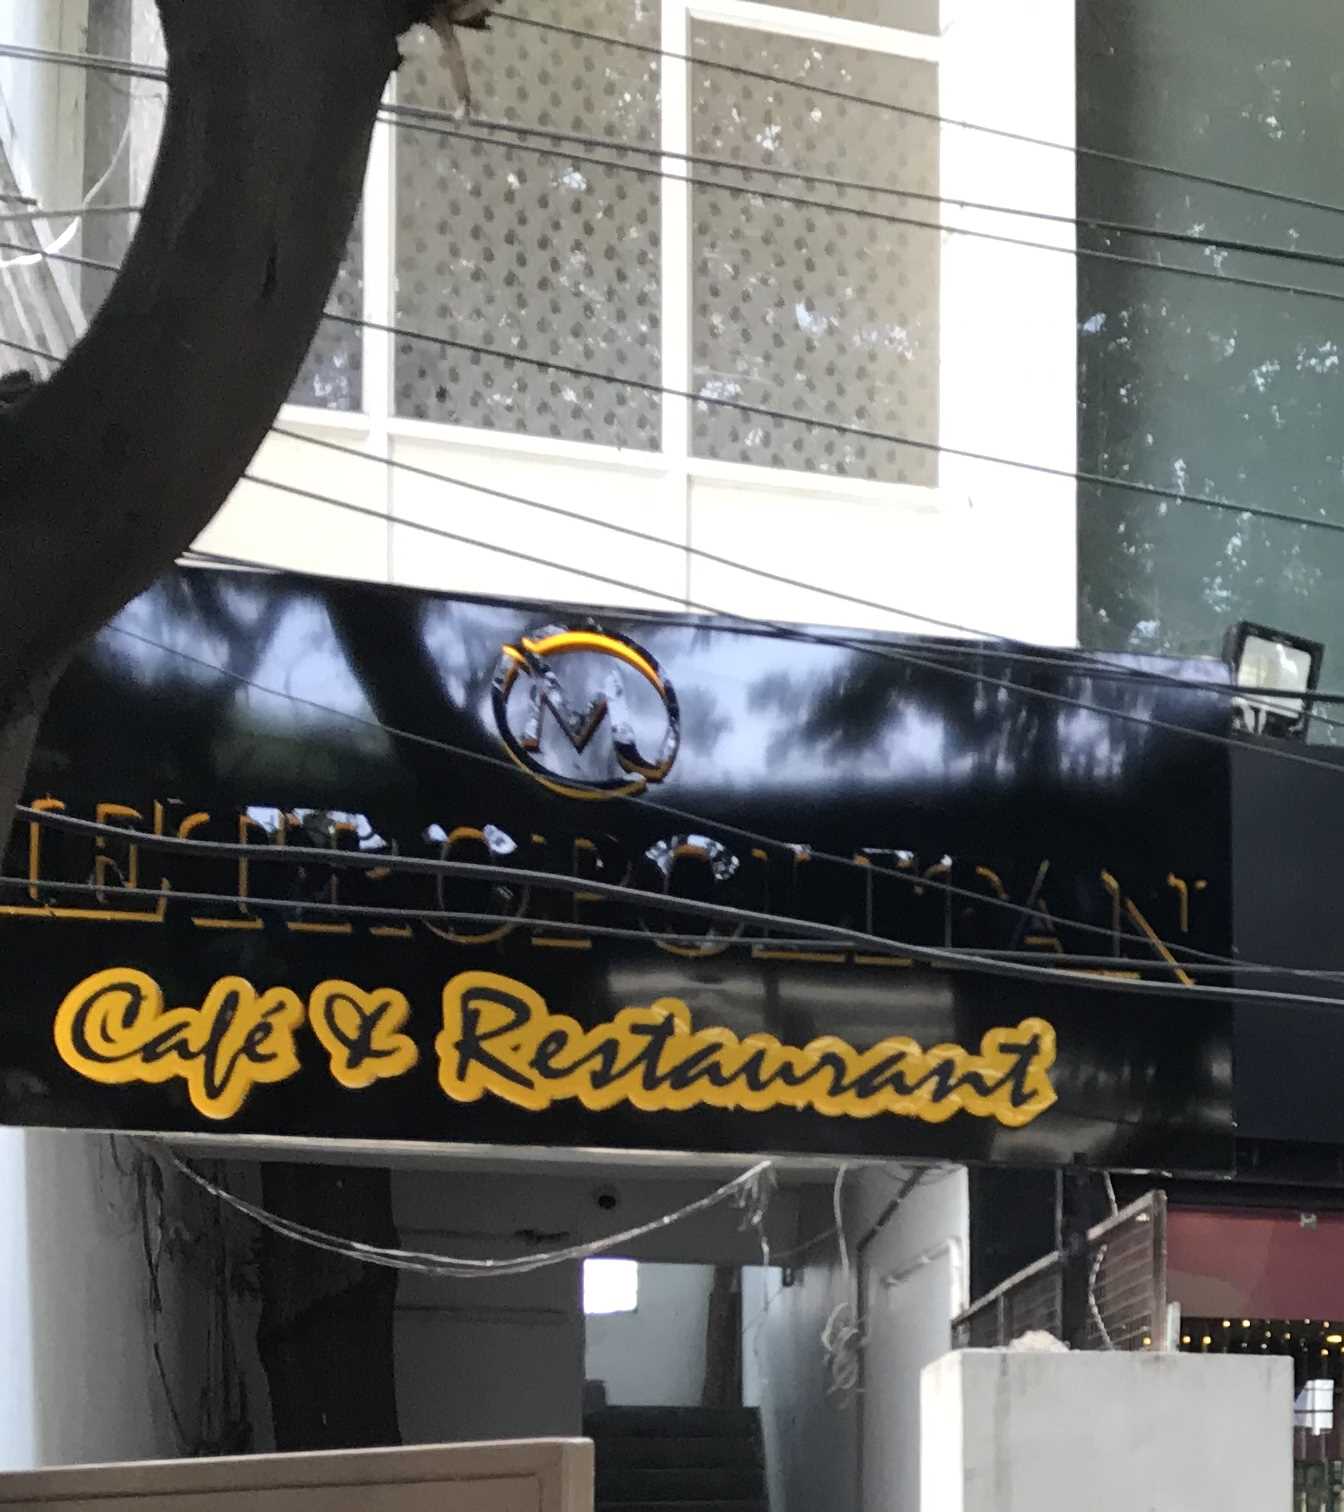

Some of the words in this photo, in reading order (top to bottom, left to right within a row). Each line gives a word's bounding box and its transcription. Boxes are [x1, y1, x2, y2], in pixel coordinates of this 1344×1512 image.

[0, 790, 1208, 987] ETROPOLITAN
[54, 967, 304, 1120] Café
[308, 979, 418, 1088] &
[435, 970, 1057, 1127] Restaurant
